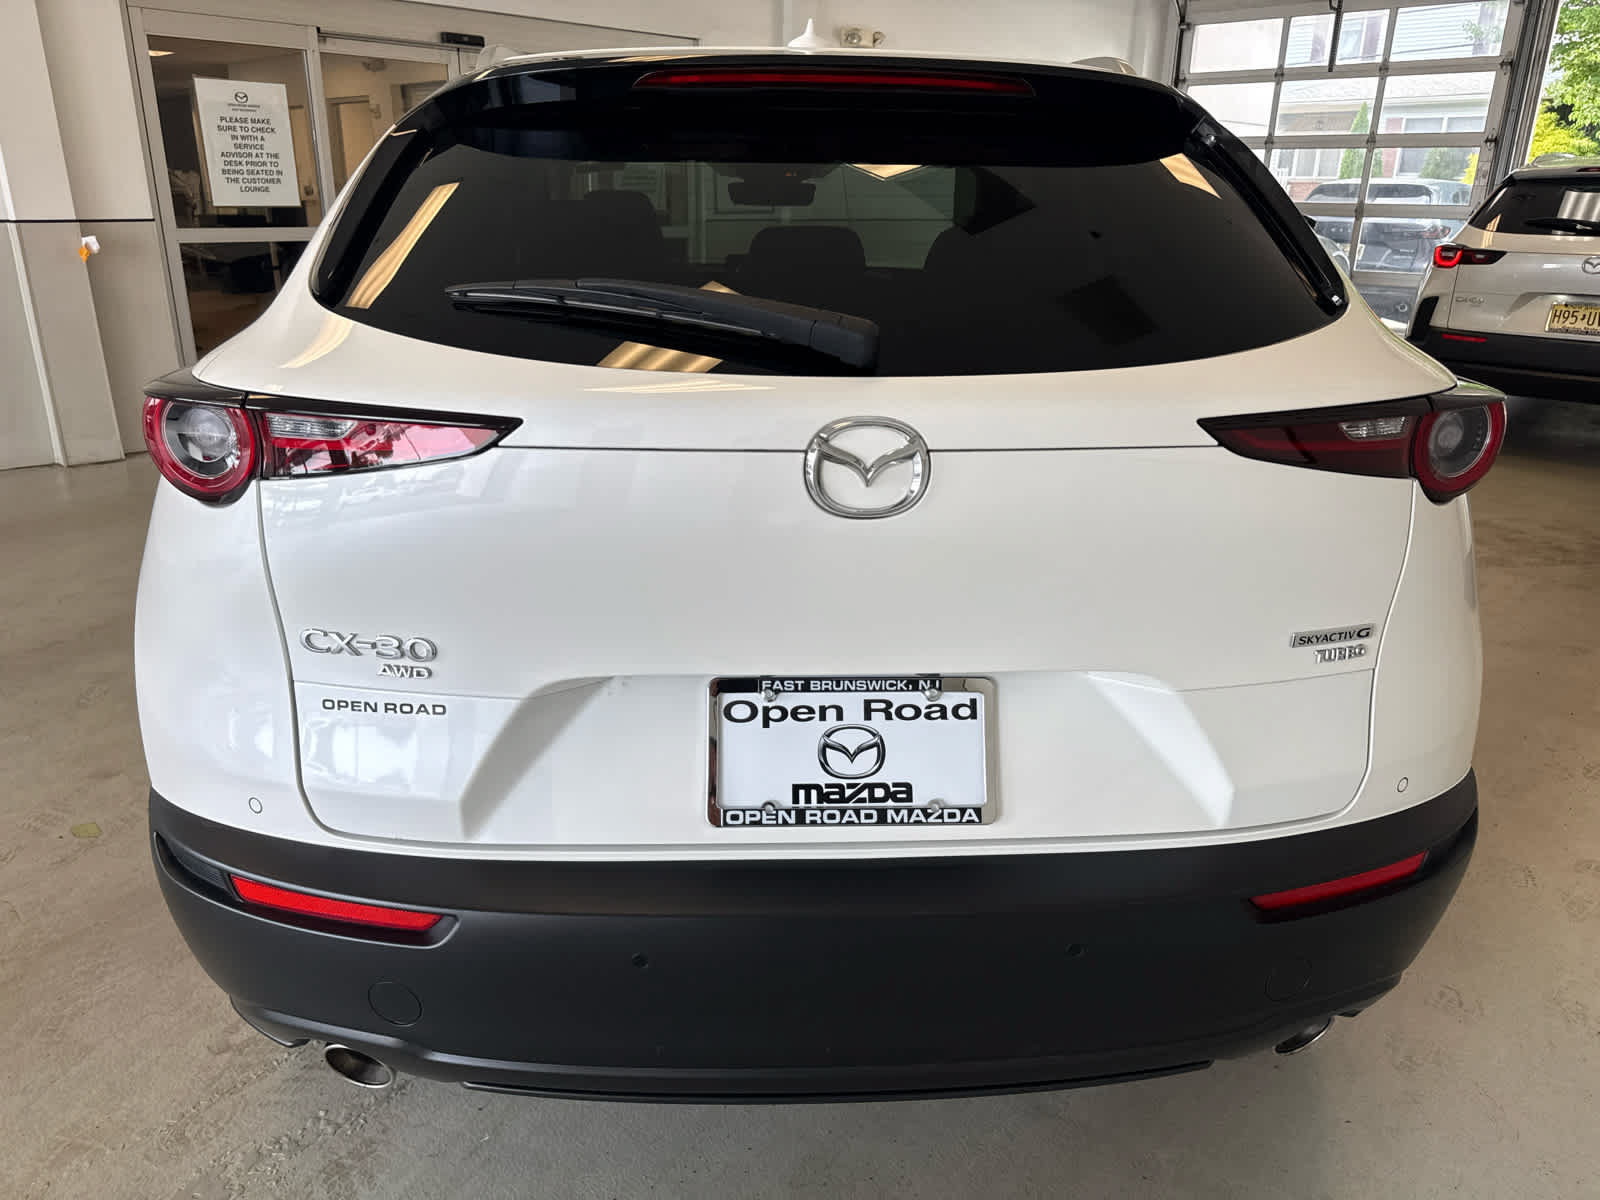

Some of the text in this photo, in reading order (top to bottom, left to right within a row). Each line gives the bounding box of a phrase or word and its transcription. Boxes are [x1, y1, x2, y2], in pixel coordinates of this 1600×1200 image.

[220, 116, 271, 125] PLEASE MAKE
[300, 628, 438, 662] CX-30
[1314, 644, 1366, 664] TURBO
[376, 664, 433, 679] AWD
[762, 680, 804, 691] EAST
[810, 680, 913, 691] BRUNSWICK,
[322, 698, 447, 715] OPEN ROAD
[723, 698, 978, 728] Open Road
[726, 808, 980, 825] OPEN ROAD MAZDA
